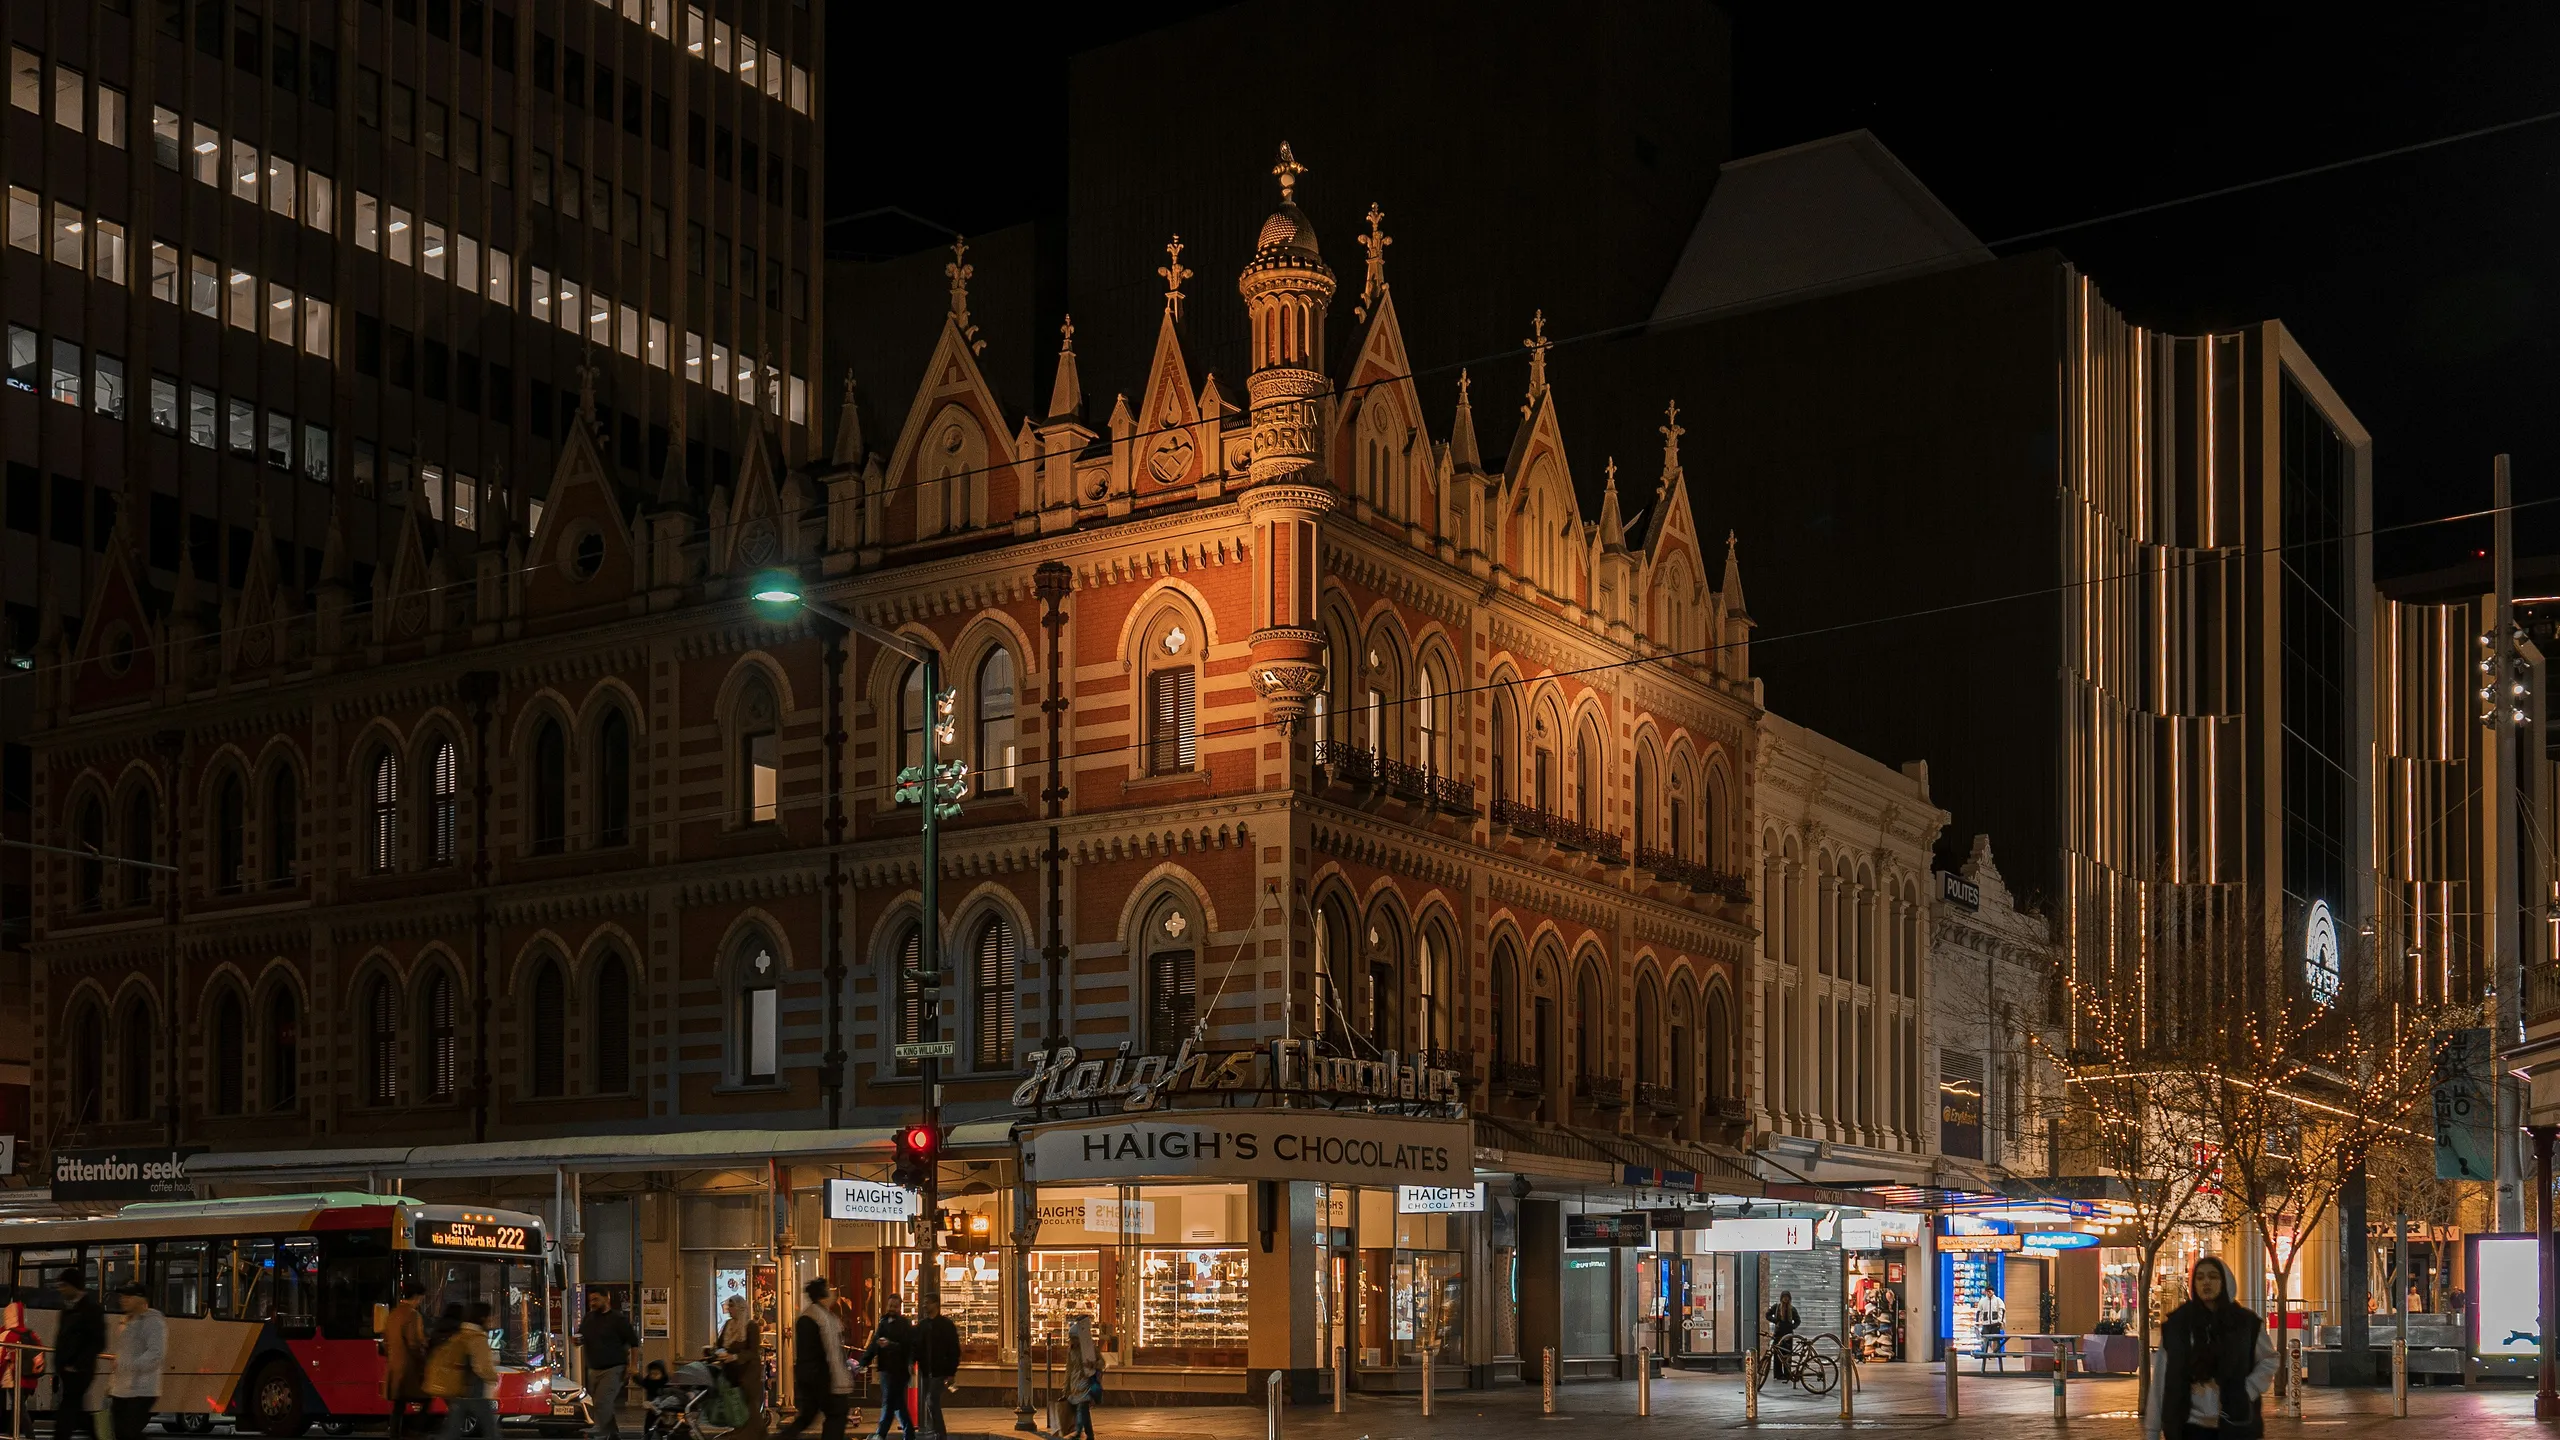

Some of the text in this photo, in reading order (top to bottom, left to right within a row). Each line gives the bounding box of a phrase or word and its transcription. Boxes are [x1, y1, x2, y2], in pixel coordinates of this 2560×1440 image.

[1947, 877, 1979, 905] POLITES
[903, 1046, 918, 1056] KING
[919, 1045, 943, 1055] WILLIAM
[944, 1044, 952, 1054] ST
[2454, 1084, 2471, 1116] OF
[1082, 1131, 1449, 1173] HAIGH'S CHOCOLATES
[56, 1151, 185, 1182] attention seek
[150, 1180, 173, 1193] coffee
[1408, 1187, 1475, 1200] HAIGH'S
[845, 1188, 904, 1204] HAIGH'S
[1814, 1189, 1843, 1204] GONG CHA
[845, 1204, 904, 1215] CHOCOLATES
[1408, 1201, 1475, 1210] CHOCOLATES
[451, 1223, 475, 1235] CITY
[1609, 1231, 1644, 1239] EXCHANGE
[432, 1232, 497, 1248] via Main North Rd
[497, 1226, 525, 1250] 222
